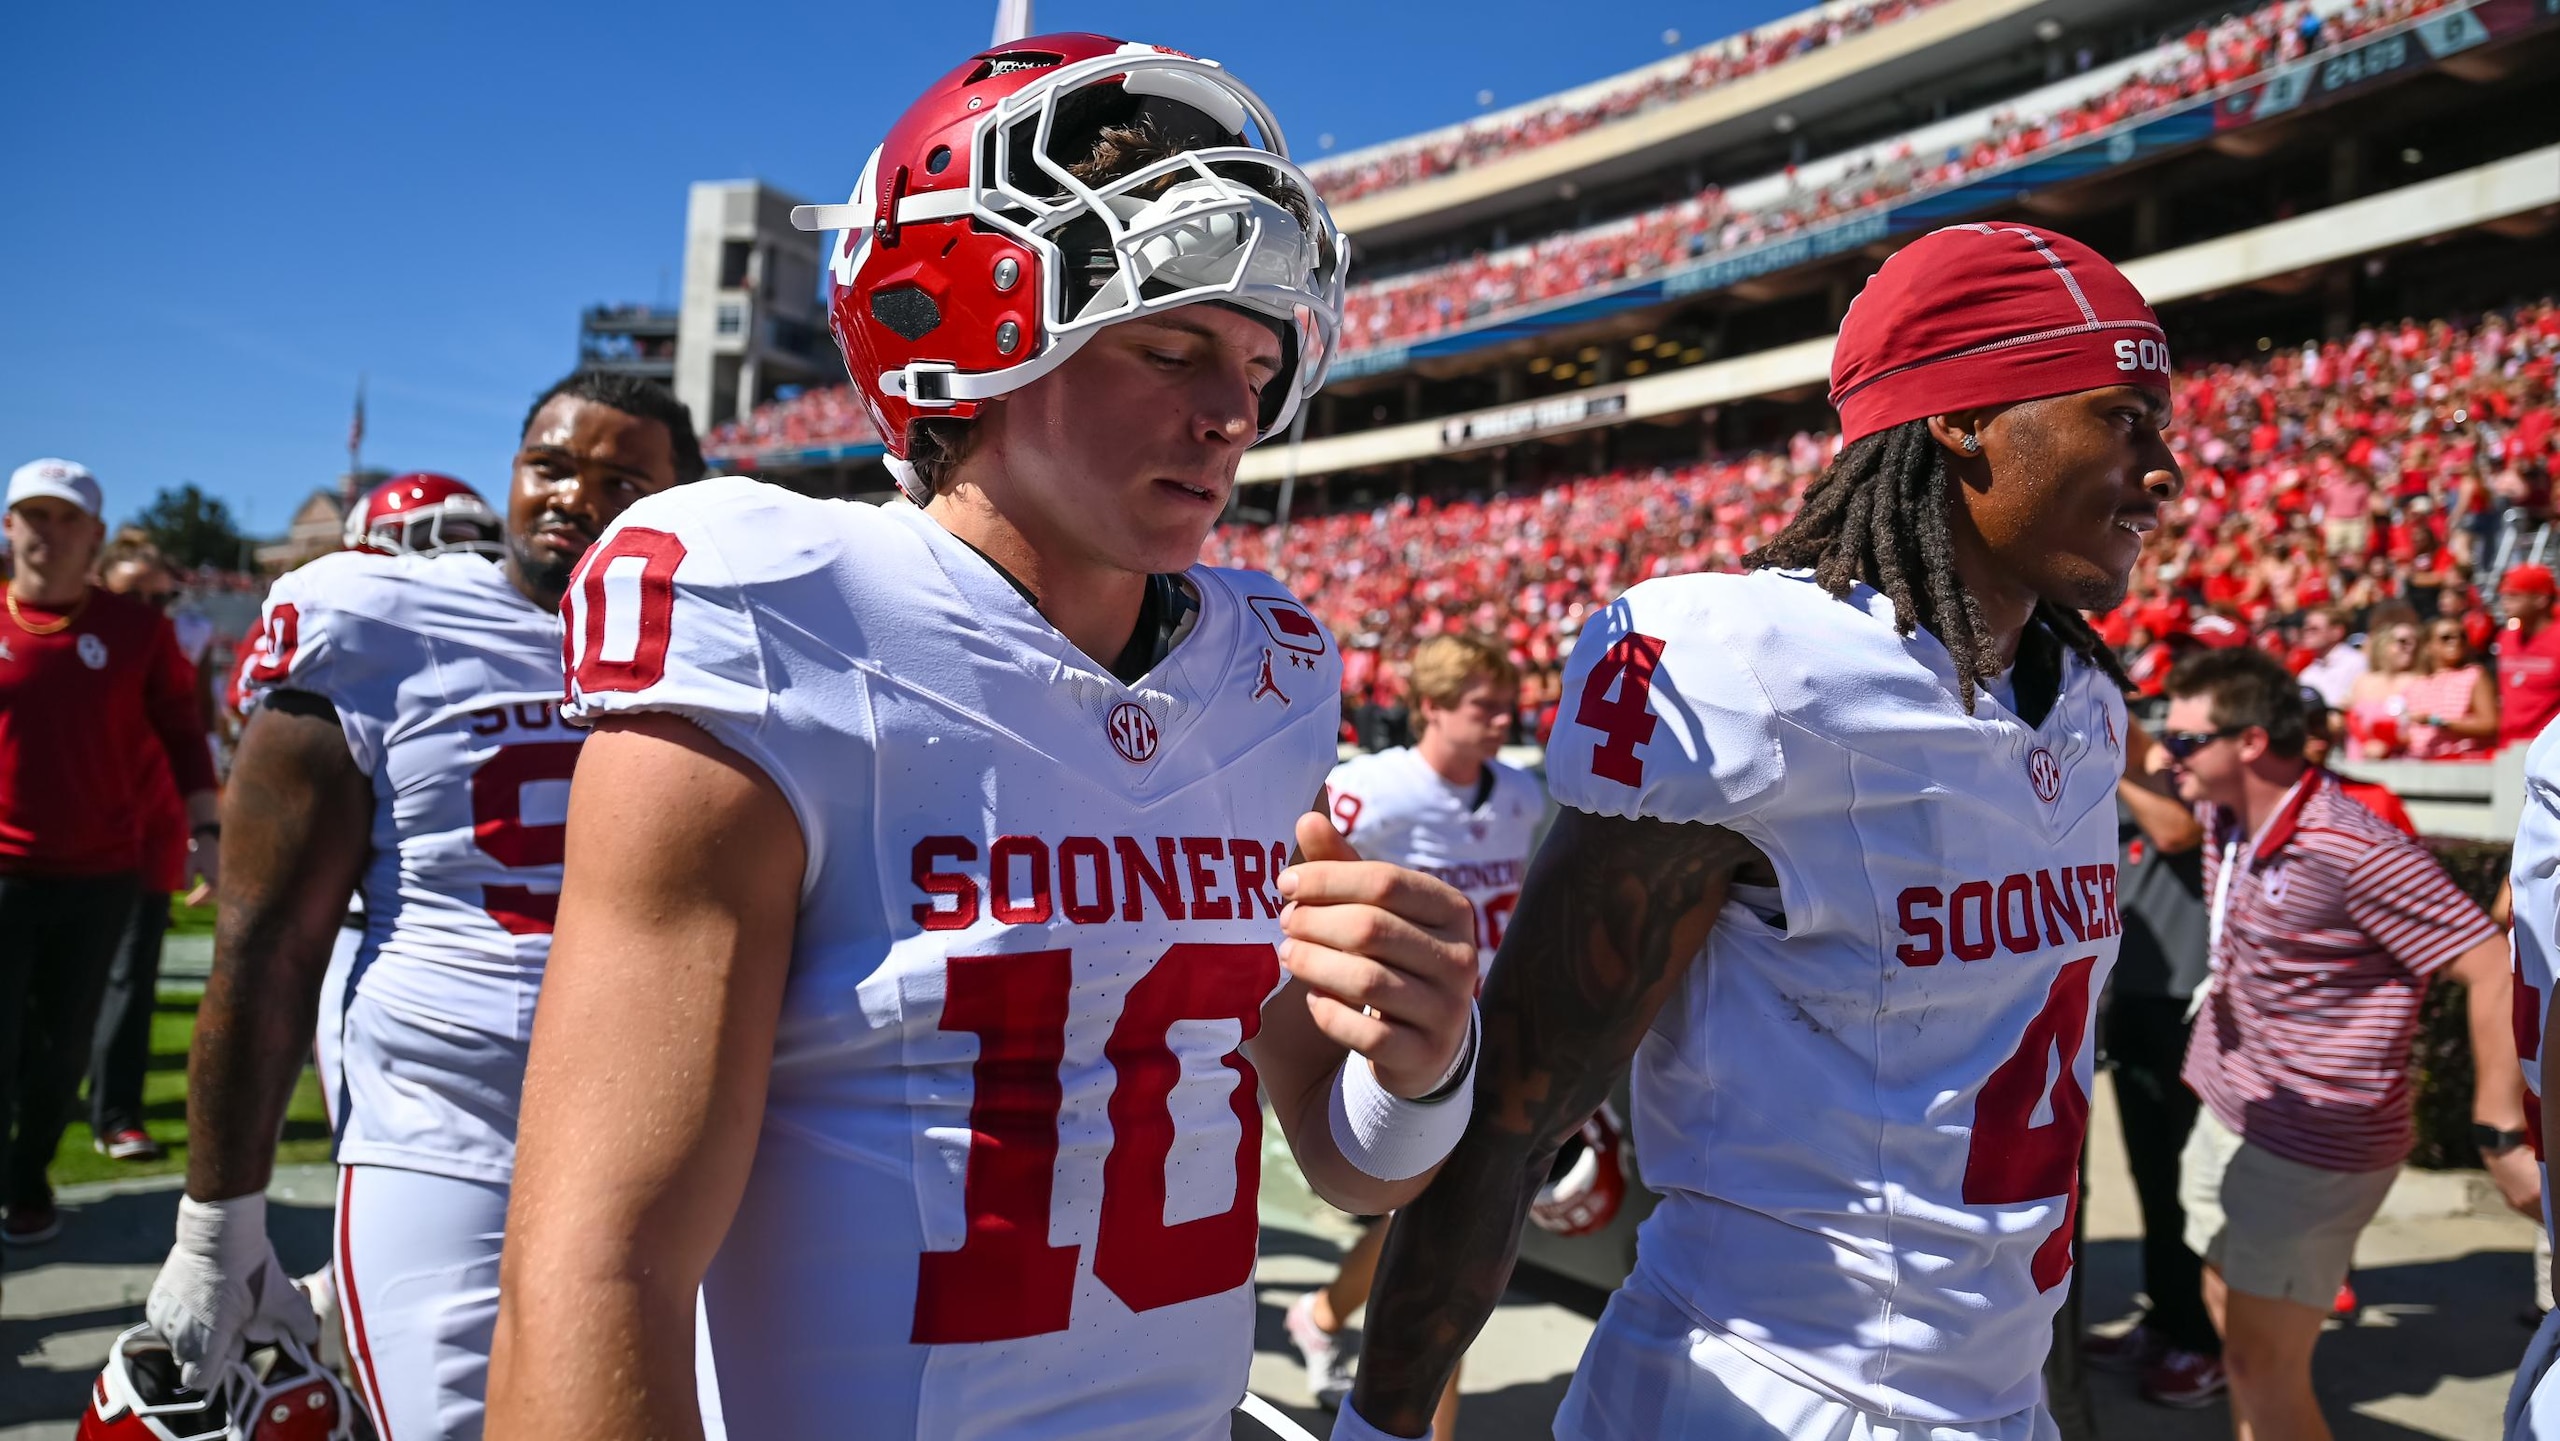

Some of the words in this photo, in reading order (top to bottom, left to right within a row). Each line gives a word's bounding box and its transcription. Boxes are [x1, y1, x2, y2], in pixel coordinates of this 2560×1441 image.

[2114, 339, 2171, 379] SOO
[1110, 704, 1158, 760] SEC
[1575, 631, 1666, 788] 4
[2031, 752, 2059, 799] SEC
[911, 835, 1287, 931] SOONERS
[1896, 864, 2121, 967] SOONER
[910, 943, 1281, 1344] 10
[1963, 956, 2098, 1294] 4
